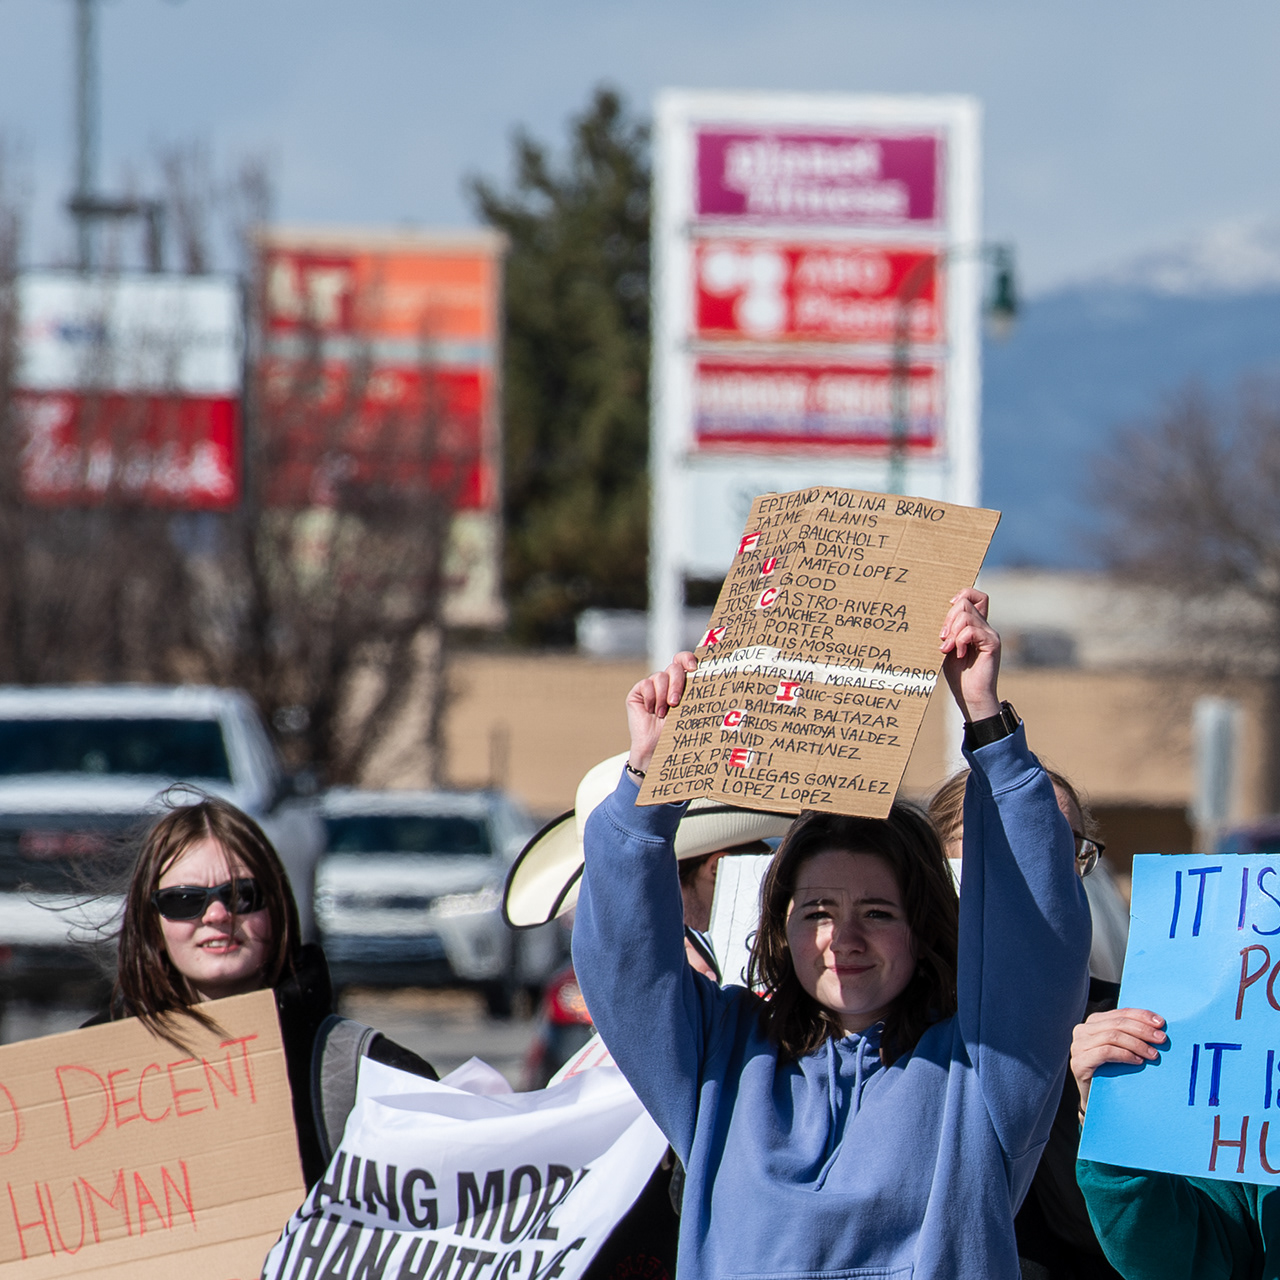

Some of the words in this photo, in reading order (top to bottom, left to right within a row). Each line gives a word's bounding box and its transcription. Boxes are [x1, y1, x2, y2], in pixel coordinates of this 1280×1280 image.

[754, 508, 805, 531] JAIME
[816, 508, 878, 528] ALANIS
[759, 489, 819, 513] EPIFANO
[821, 490, 886, 511] MOLINA
[895, 500, 945, 521] BRAVO
[738, 526, 793, 555] FELIX
[798, 524, 889, 548] BAUCKHOLT
[740, 549, 761, 564] DR
[763, 540, 806, 559] LINDA
[815, 542, 865, 561] DAVIS
[733, 556, 790, 579] MANUEL
[798, 556, 850, 577] MATEO
[852, 564, 909, 583] LOPEZ
[728, 576, 772, 598] RENEE
[779, 572, 836, 592] GOOD
[720, 594, 758, 615] JOSE
[760, 587, 907, 620] CASTRO-RIVERA
[703, 621, 758, 647] KEITH
[763, 618, 834, 640] PORTER
[717, 609, 757, 629] ISAIS
[762, 606, 829, 624] SANCHEZ
[835, 614, 909, 633] BARBOZA
[706, 638, 744, 656] RYAN
[747, 633, 797, 650] LOUIS
[800, 638, 891, 662] MOSQUEDA
[697, 647, 768, 670] ENRIQUE
[771, 650, 818, 665] JUAN
[825, 654, 866, 673] TIZOL
[871, 661, 936, 681] MACARIO
[692, 666, 738, 684] ELENA
[742, 664, 814, 683] CATARINA
[825, 673, 932, 698] MORALES-CHAN
[675, 714, 723, 731] ROBERTO
[723, 710, 778, 732] CARLOS
[781, 721, 836, 739] MONTOYA
[840, 726, 901, 747] VALDEZ
[680, 699, 738, 718] BARTOLO
[745, 699, 807, 719] BALTAZAR
[813, 708, 899, 729] BALTAZAR
[662, 750, 704, 769] ALEX
[709, 748, 773, 768] PRETTI
[672, 731, 713, 752] YAHIR
[720, 730, 764, 747] DAVID
[769, 737, 861, 760] MARTINEZ
[658, 762, 718, 782] SILVERIO
[724, 766, 800, 785] VILLEGAS
[651, 778, 715, 798] HECTOR
[722, 779, 775, 799] LOPEZ
[780, 787, 833, 804] LOPEZ
[1168, 866, 1222, 939] IT
[1187, 1041, 1243, 1108] IT
[55, 1034, 258, 1151] DECENT
[296, 1150, 438, 1230] HING
[5, 1159, 197, 1260] HUMAN
